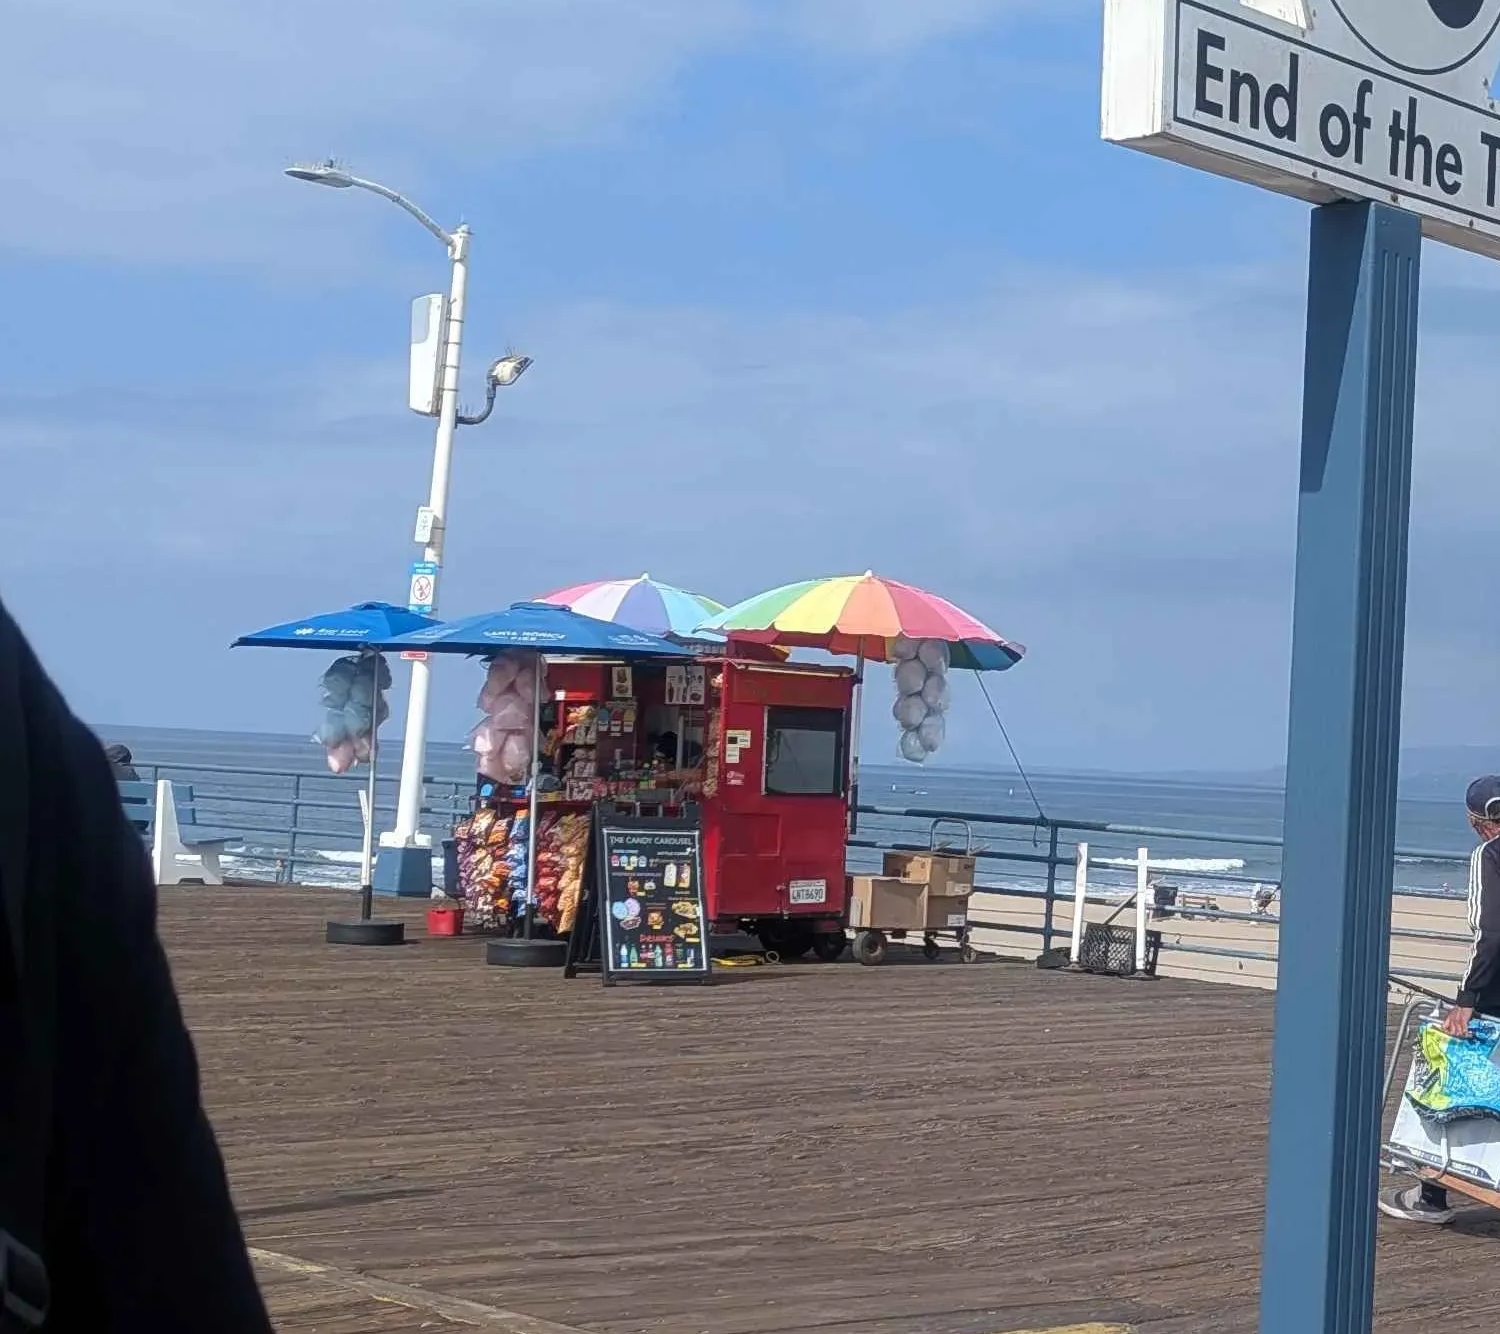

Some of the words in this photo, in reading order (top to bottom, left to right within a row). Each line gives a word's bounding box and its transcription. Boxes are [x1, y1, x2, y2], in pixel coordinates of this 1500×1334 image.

[1194, 28, 1299, 143] End
[1320, 79, 1373, 165] of
[1389, 97, 1463, 196] the
[626, 836, 652, 845] CANDY
[654, 837, 693, 846] CAROUSEL
